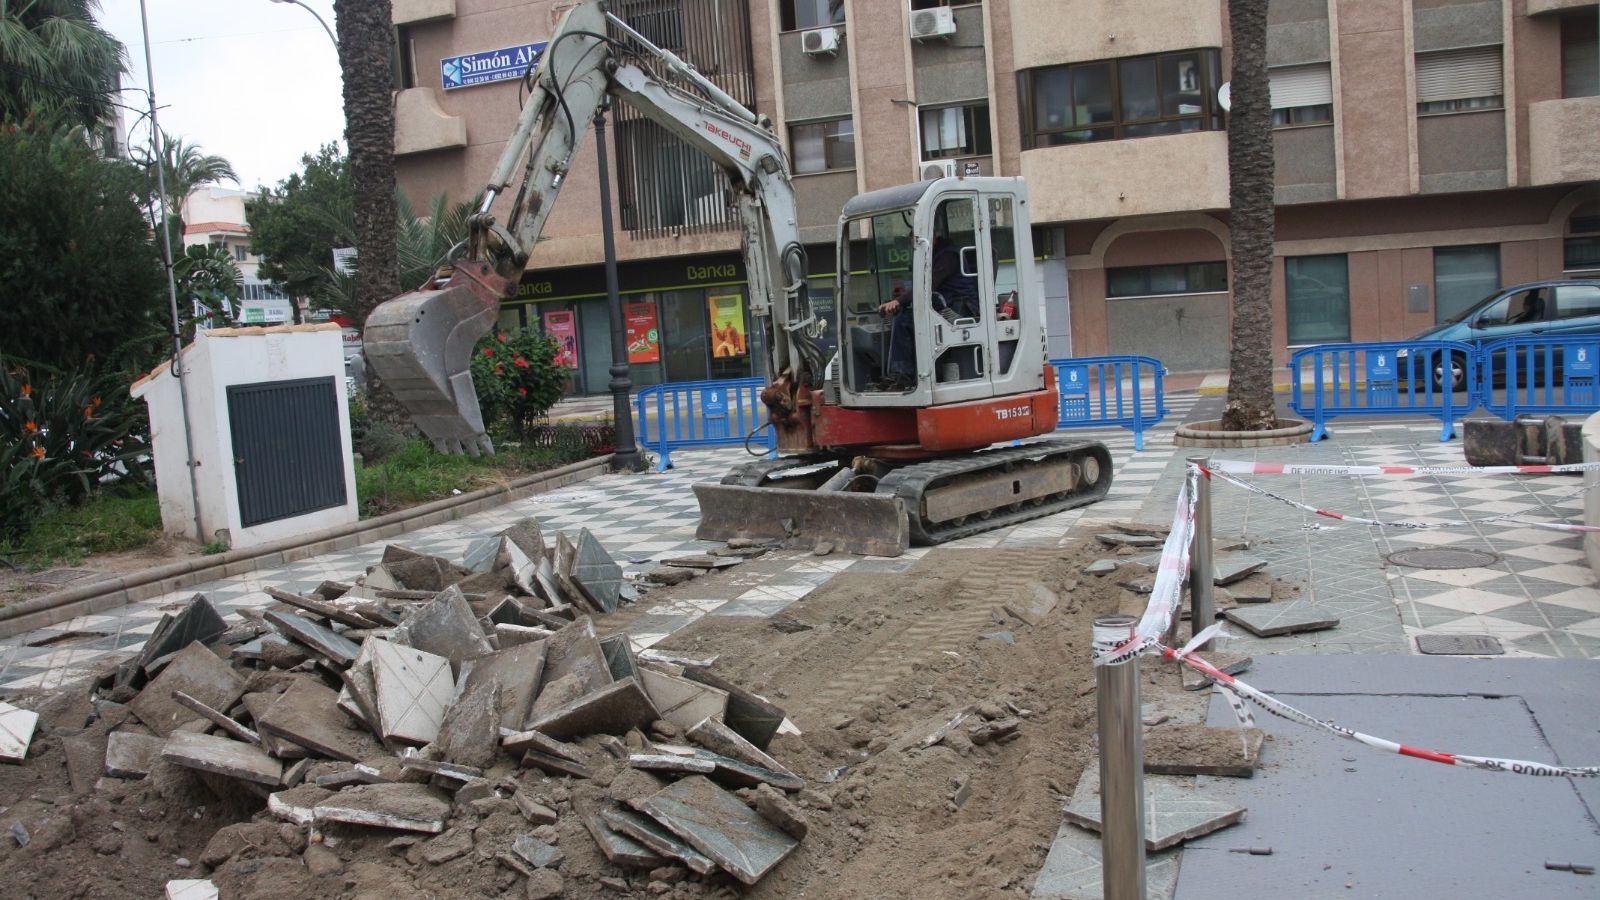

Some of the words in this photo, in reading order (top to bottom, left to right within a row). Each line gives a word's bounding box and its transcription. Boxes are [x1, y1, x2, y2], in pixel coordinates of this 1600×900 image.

[461, 51, 511, 74] Simón
[515, 47, 537, 65] Ab
[687, 264, 736, 280] Bankia
[517, 281, 552, 296] ankia
